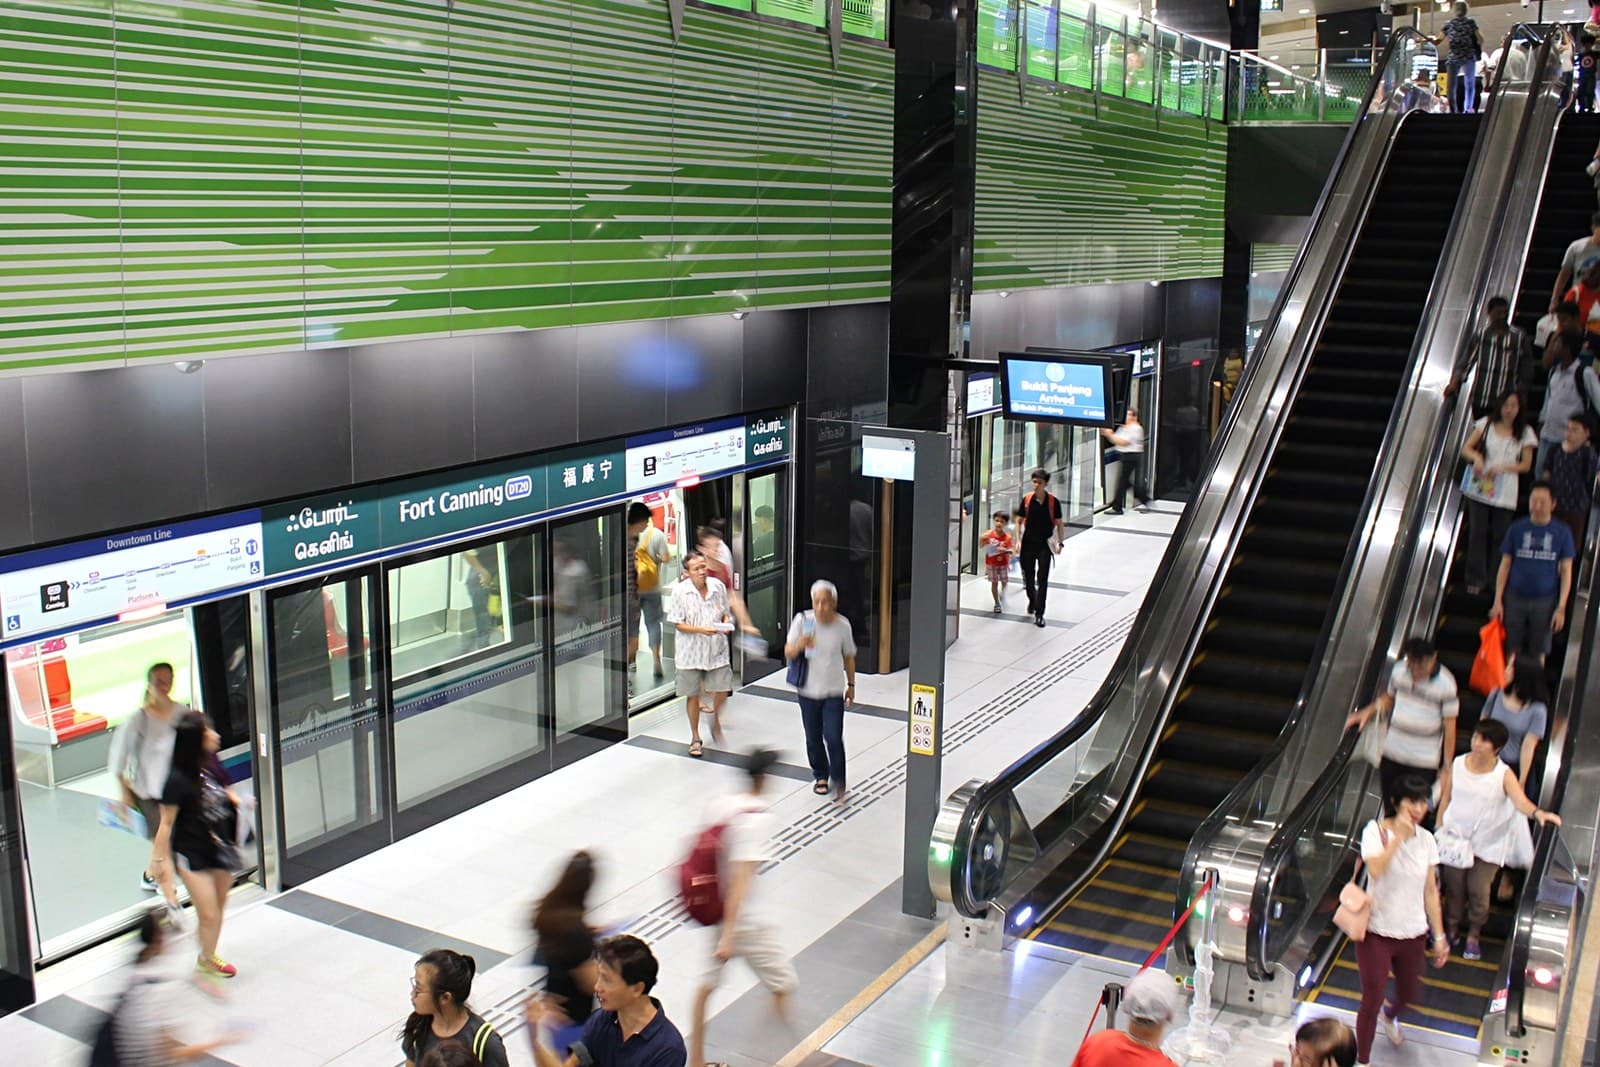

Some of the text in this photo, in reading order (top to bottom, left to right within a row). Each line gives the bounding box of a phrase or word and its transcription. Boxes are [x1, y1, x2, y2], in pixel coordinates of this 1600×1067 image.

[1021, 380, 1092, 397] Bukit Panjang
[563, 459, 612, 488] 福康宁
[400, 481, 529, 522] Fort Canning DT20
[107, 529, 172, 550] Downtown Line
